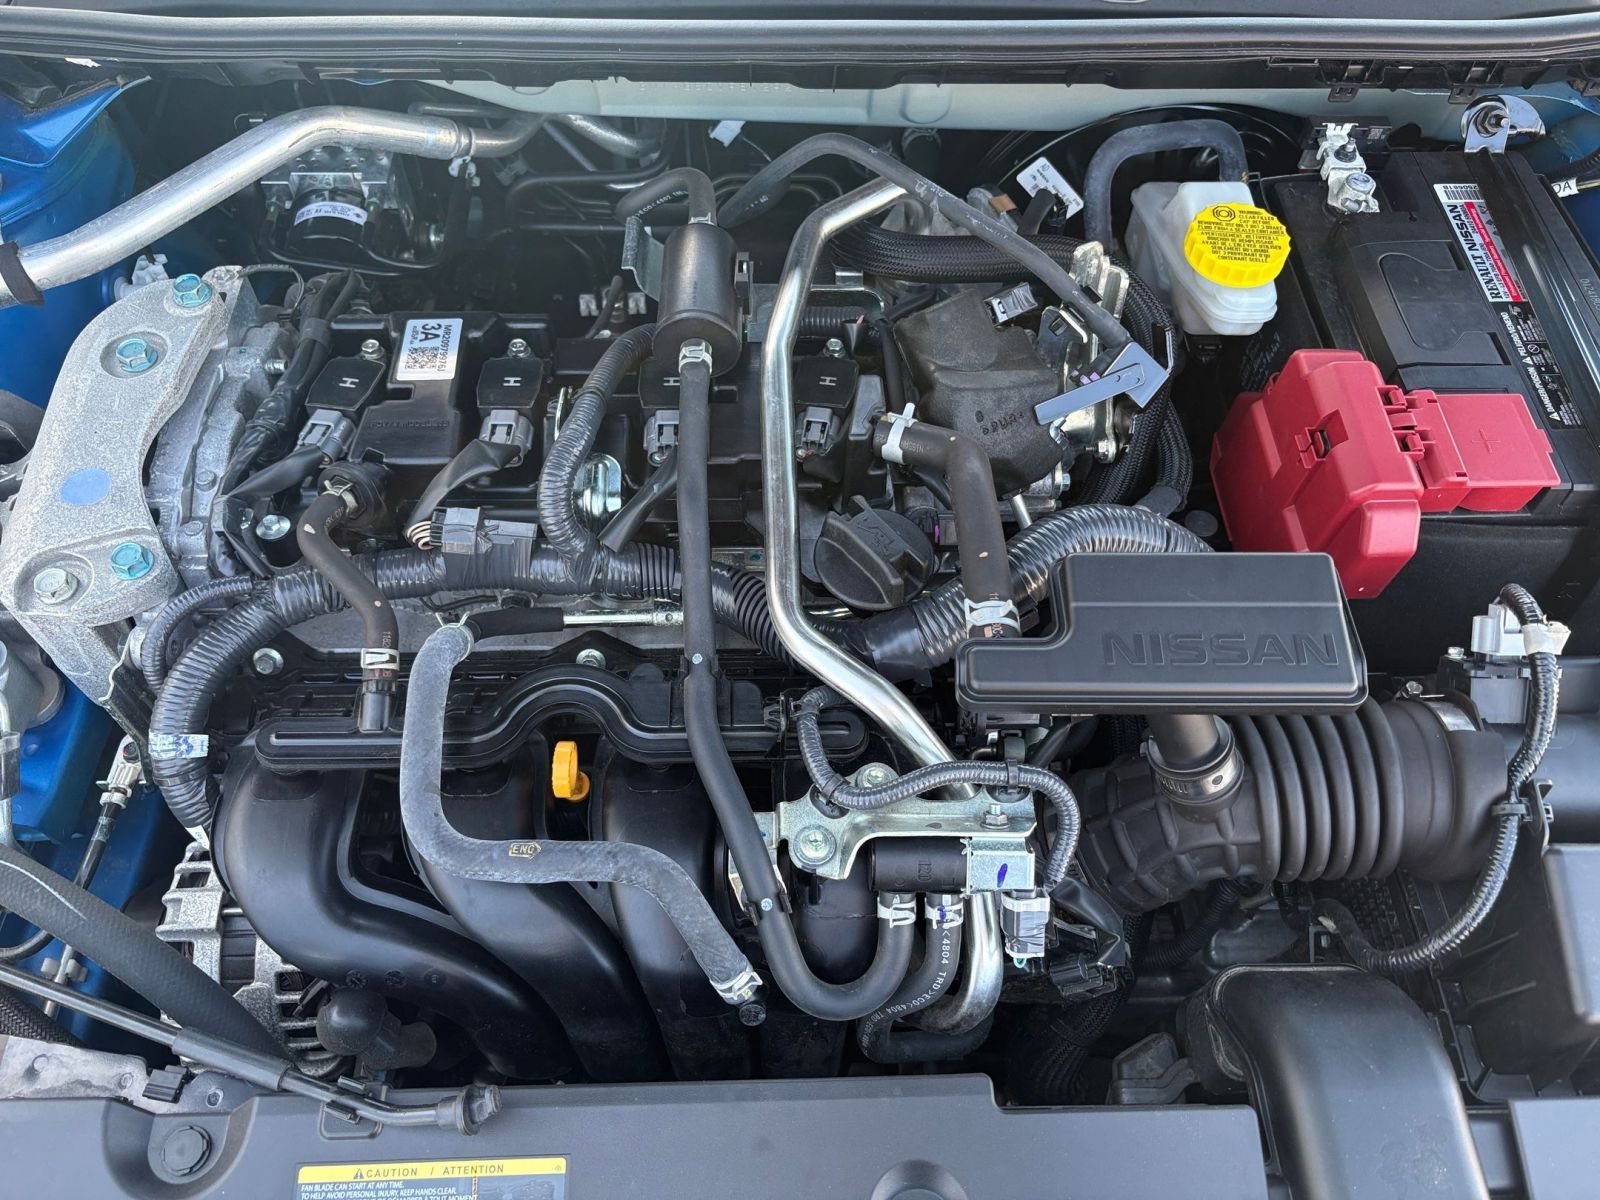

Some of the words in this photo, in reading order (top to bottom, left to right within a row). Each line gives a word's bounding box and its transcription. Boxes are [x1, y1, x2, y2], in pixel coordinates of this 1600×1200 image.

[1447, 205, 1479, 251] NISSAN
[1471, 254, 1503, 299] RENAULT
[419, 324, 442, 342] 3A
[503, 377, 522, 386] H
[819, 376, 837, 386] H
[1527, 367, 1555, 412] DANGER/POISON
[1101, 632, 1339, 666] NISSAN
[512, 844, 535, 854] ENG
[366, 1168, 418, 1178] CAUTION
[443, 1164, 504, 1175] ATTENTION
[346, 1190, 376, 1199] PERSONAL
